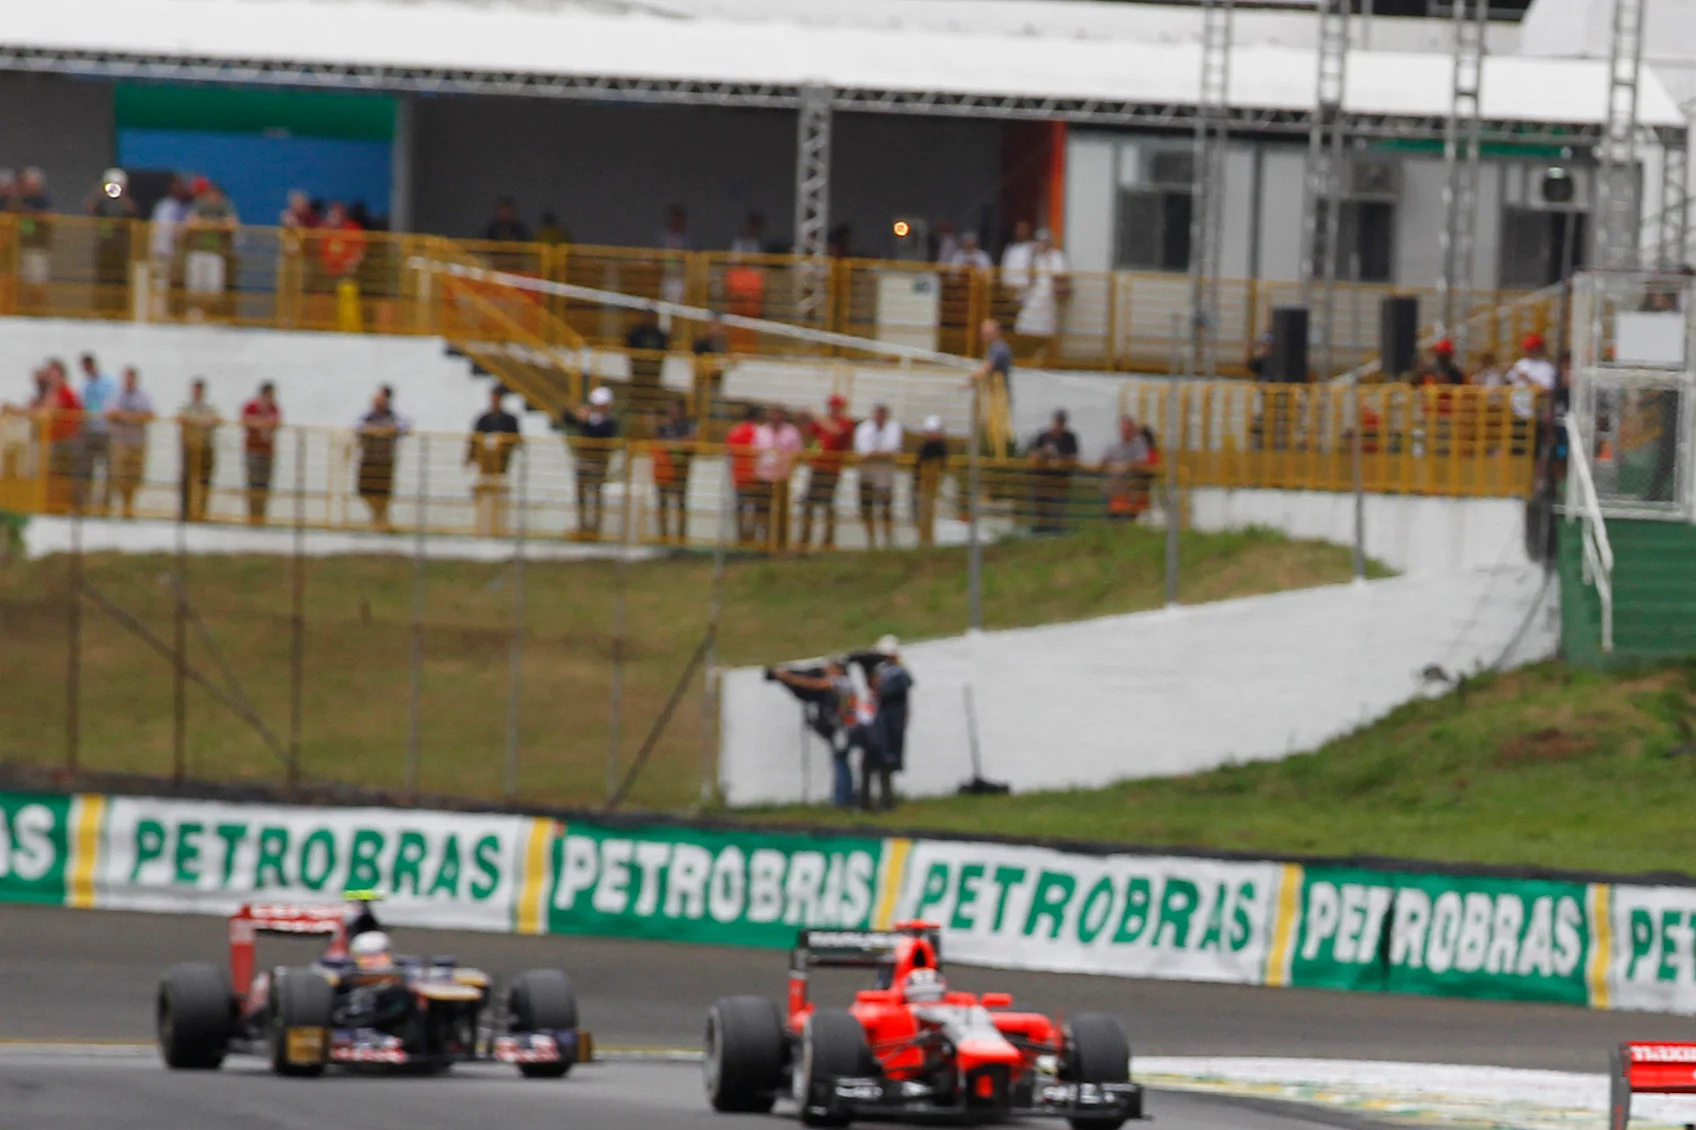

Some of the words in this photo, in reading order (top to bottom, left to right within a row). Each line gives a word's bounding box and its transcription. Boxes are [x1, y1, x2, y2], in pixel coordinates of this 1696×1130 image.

[0, 803, 57, 881] S
[131, 819, 501, 899] PETROBRAS
[554, 835, 875, 929] PETROBRAS
[916, 862, 1256, 952] PETROBRAS
[1302, 881, 1583, 977] PETROBRAS
